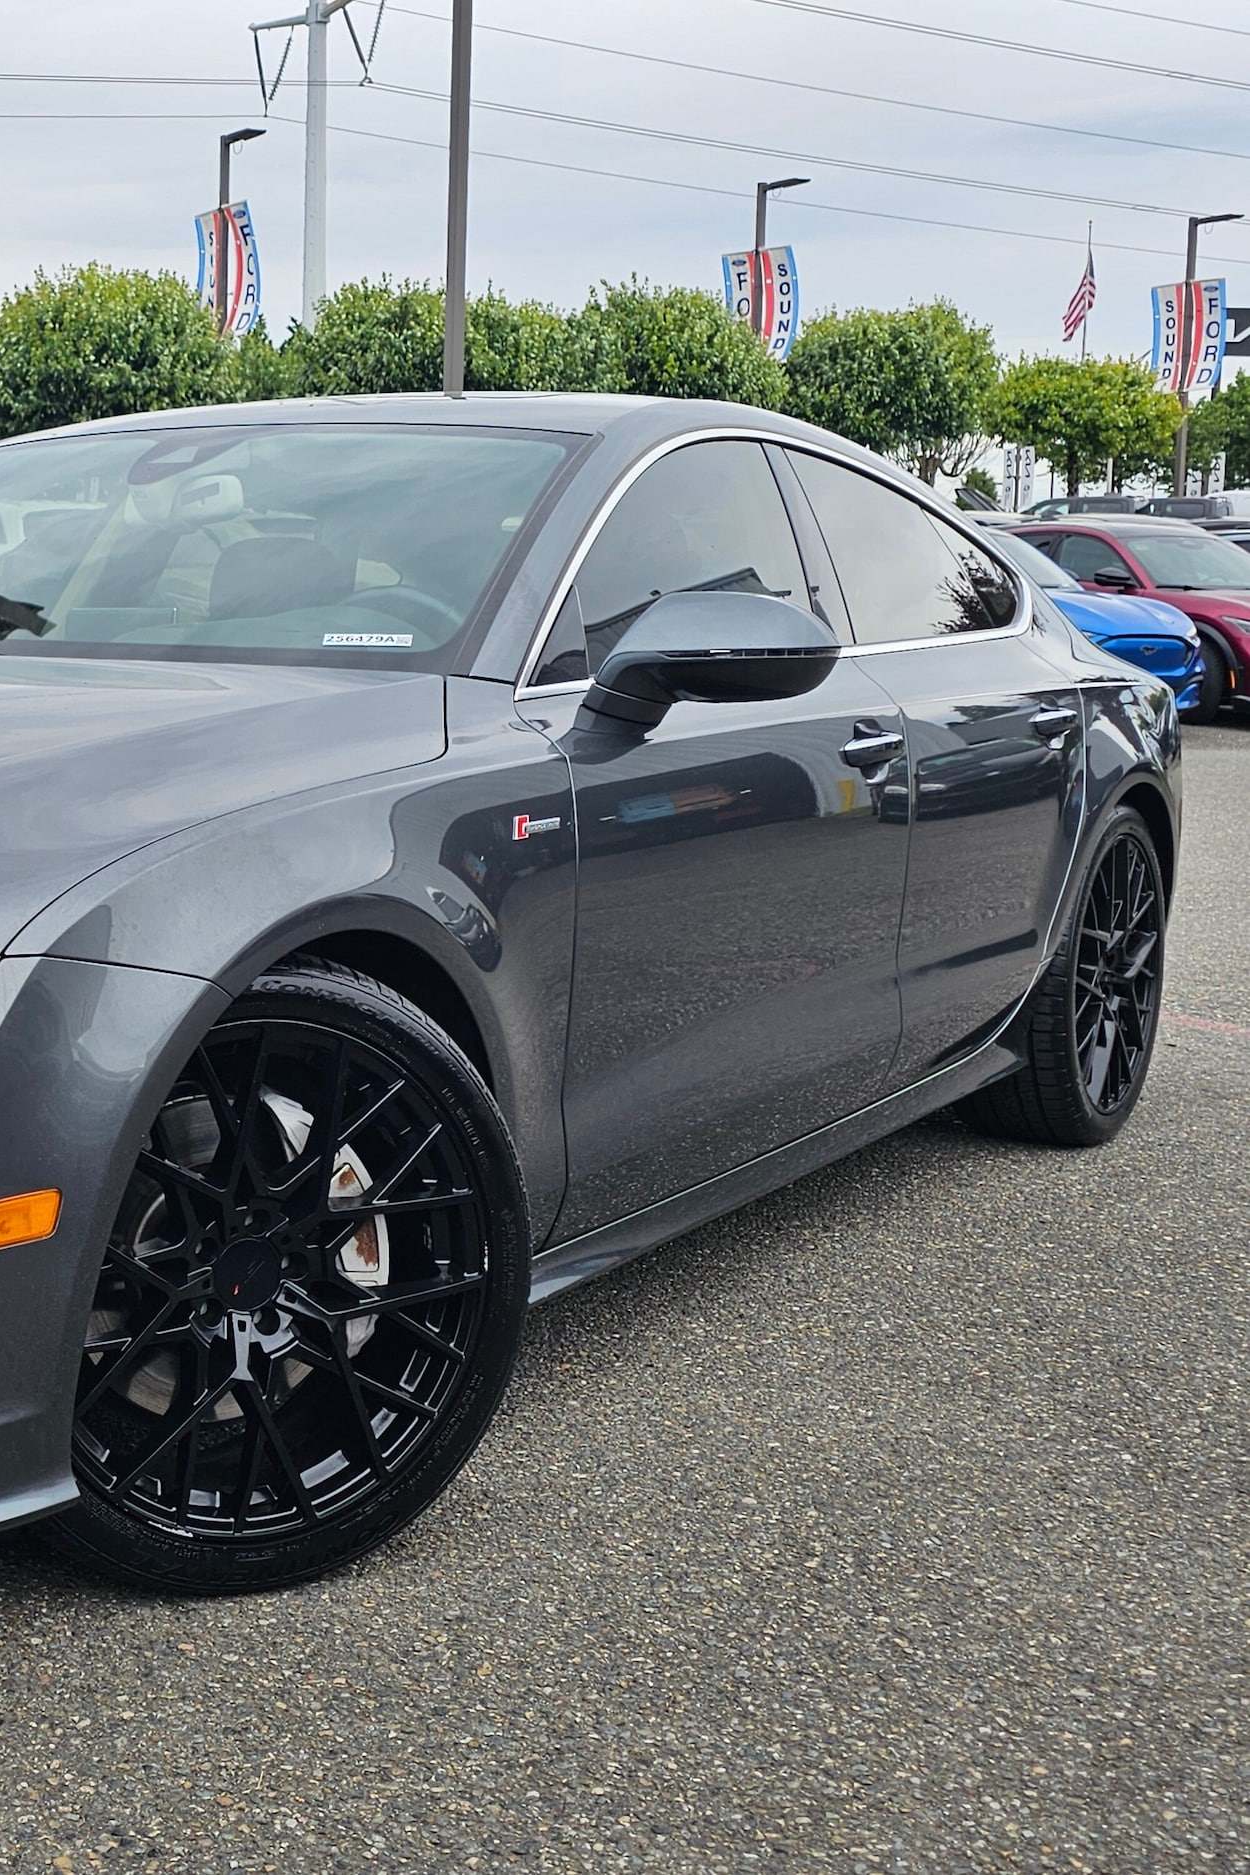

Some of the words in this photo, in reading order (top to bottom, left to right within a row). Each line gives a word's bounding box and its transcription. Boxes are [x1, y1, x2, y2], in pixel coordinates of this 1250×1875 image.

[736, 271, 750, 316] FO
[773, 264, 791, 349] SOUND
[1162, 300, 1176, 379] SOUND
[1196, 298, 1220, 384] FORD
[325, 635, 395, 643] 256479A
